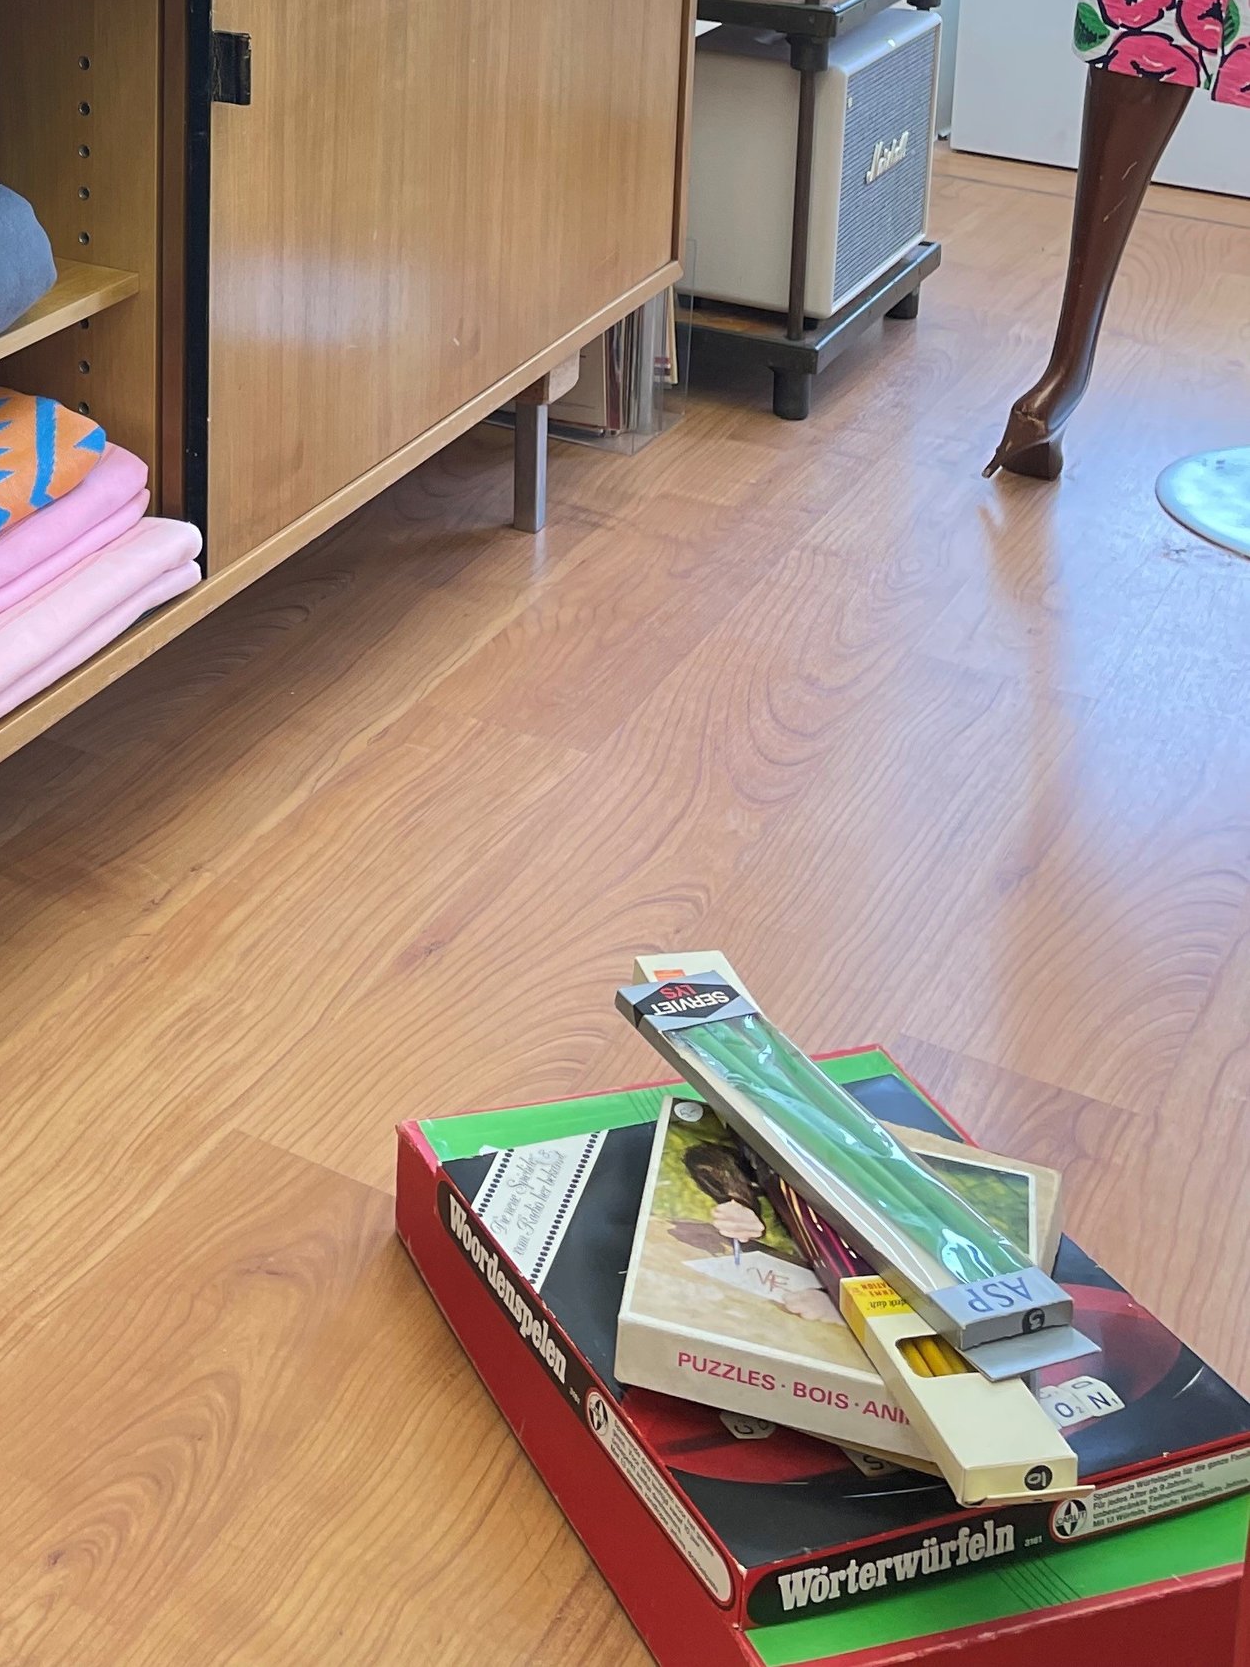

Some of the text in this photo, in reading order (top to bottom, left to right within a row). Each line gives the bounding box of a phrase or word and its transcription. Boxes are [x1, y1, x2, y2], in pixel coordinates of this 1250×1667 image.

[651, 990, 730, 1016] SERVIET
[659, 984, 696, 1000] LYS
[516, 1201, 545, 1236] Radio
[449, 1193, 567, 1384] Woordenspelen
[967, 1276, 1033, 1313] ASP
[678, 1351, 776, 1391] PUZZLES
[793, 1381, 850, 1409] BOIS
[1087, 1391, 1112, 1410] N
[778, 1520, 1015, 1611] Wörterwürfeln
